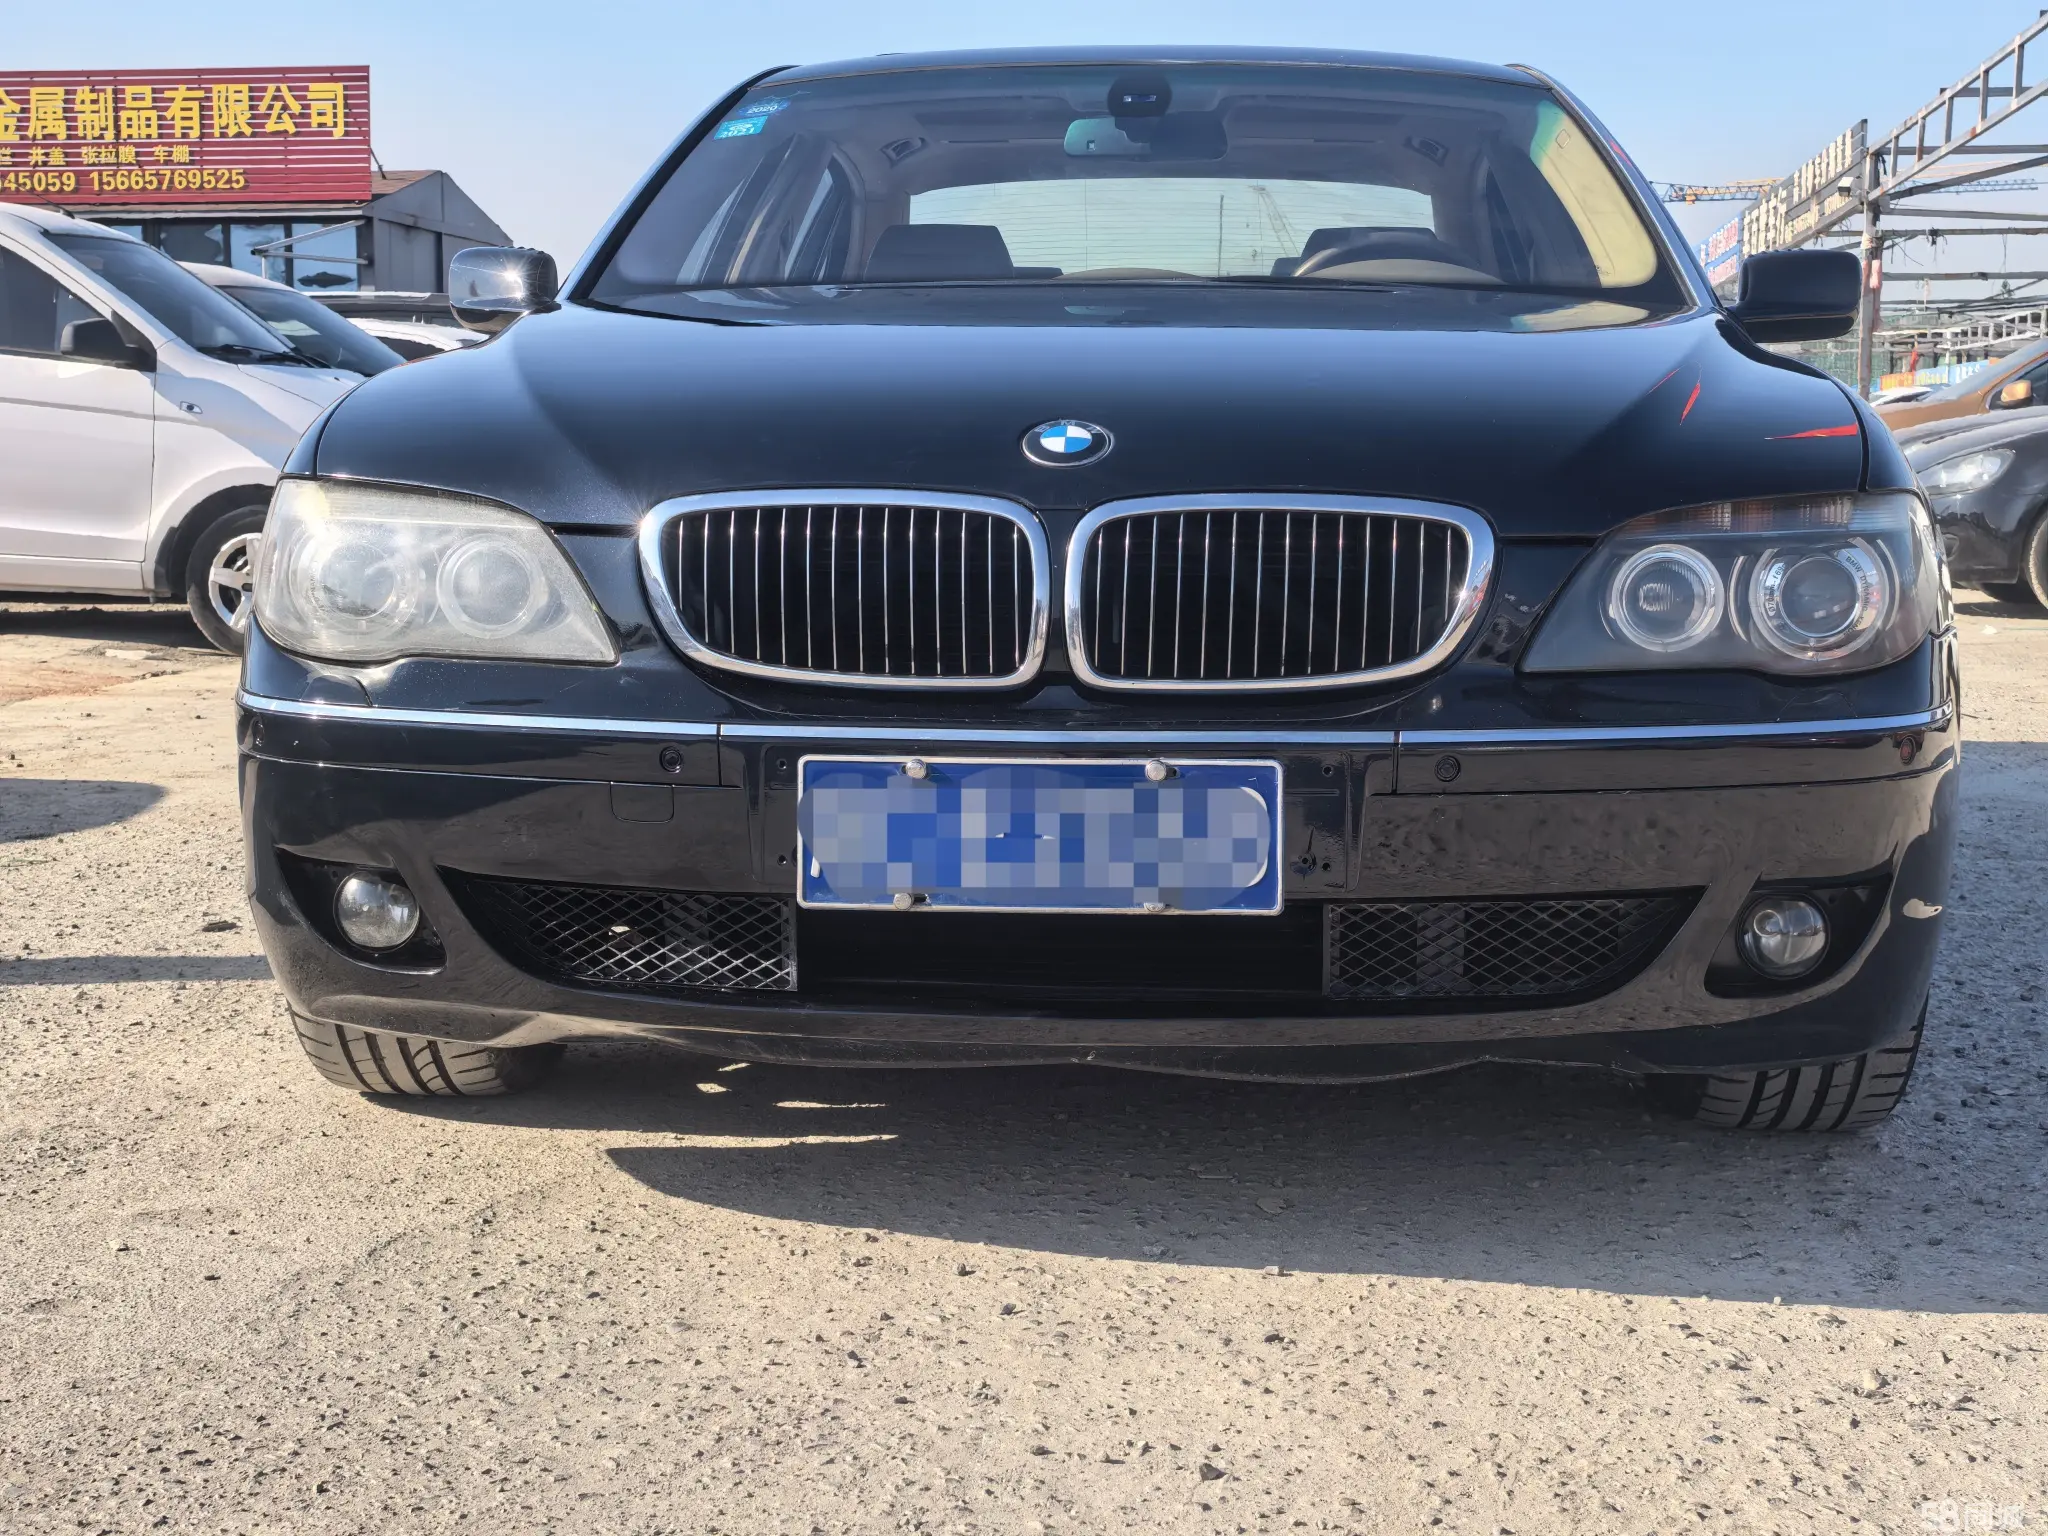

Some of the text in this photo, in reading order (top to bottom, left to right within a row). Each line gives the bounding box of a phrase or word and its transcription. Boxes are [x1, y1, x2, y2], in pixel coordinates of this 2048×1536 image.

[28, 146, 67, 166] 井盖
[81, 145, 136, 165] 张拉膜
[153, 144, 190, 164] 车棚
[0, 168, 246, 192] 45059 15665769525
[1845, 556, 1862, 573] BMW
